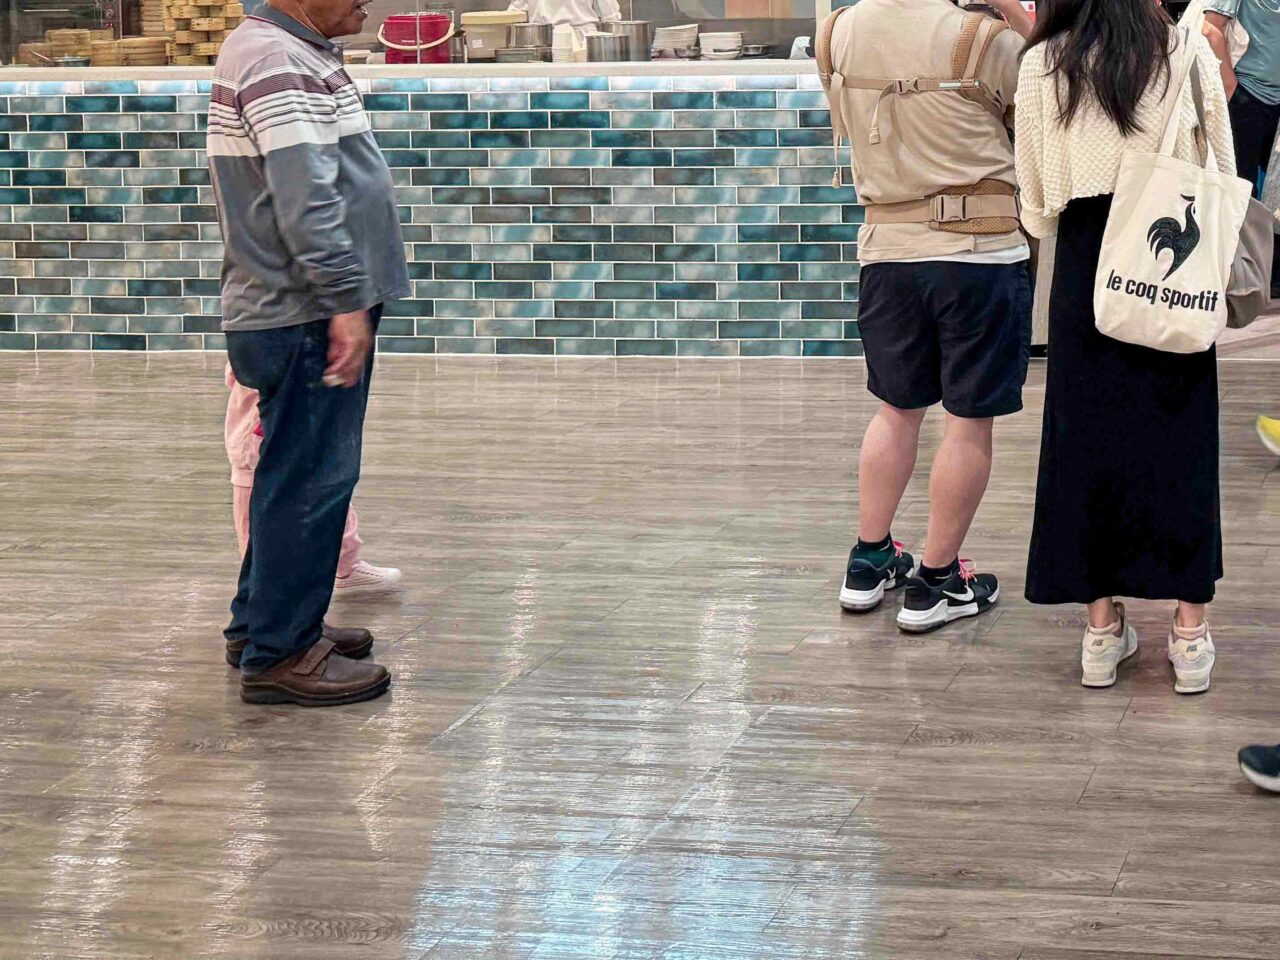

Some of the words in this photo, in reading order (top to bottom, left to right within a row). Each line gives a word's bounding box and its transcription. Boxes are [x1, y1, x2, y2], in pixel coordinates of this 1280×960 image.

[1106, 269, 1122, 291] le
[1125, 279, 1158, 305] coq
[1160, 287, 1219, 312] sportif
